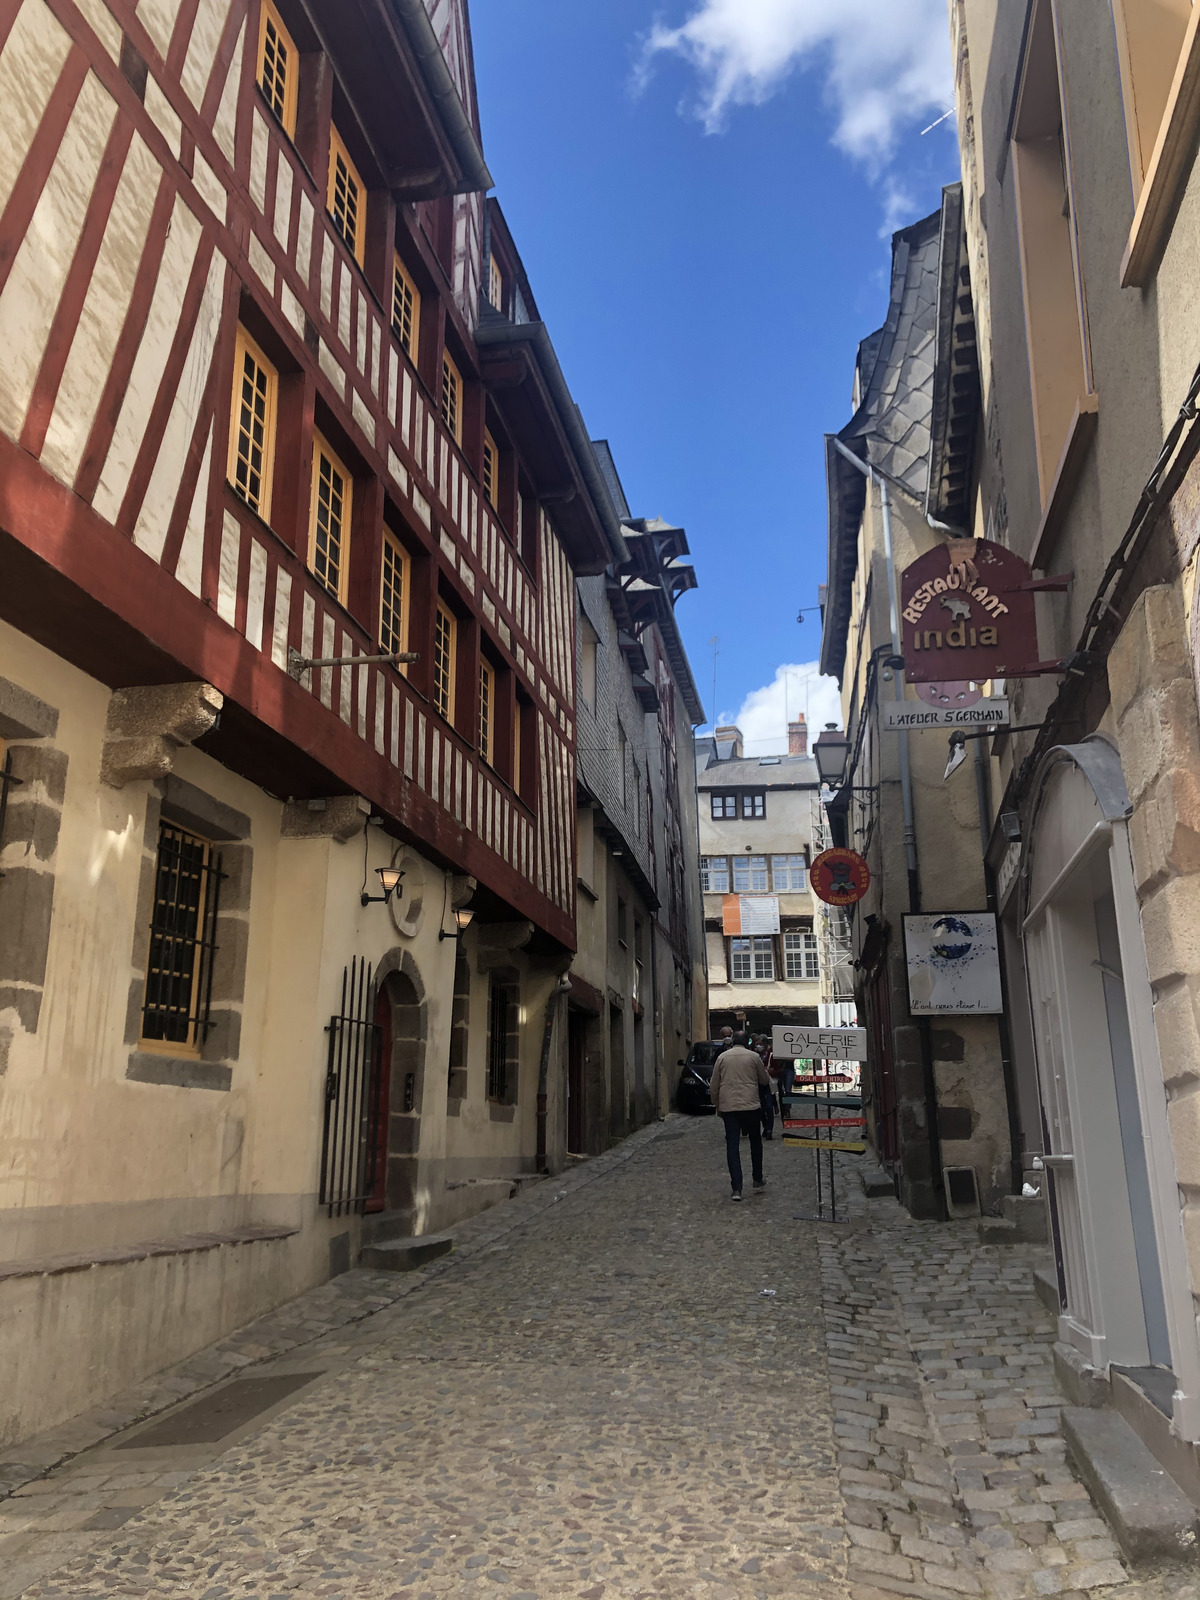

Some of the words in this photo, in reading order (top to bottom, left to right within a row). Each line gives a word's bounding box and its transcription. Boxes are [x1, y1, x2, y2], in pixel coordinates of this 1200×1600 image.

[914, 620, 998, 649] india
[889, 712, 939, 726] L'ATELIER
[911, 999, 932, 1010] L'art
[783, 1032, 857, 1047] GALERIE
[791, 1044, 852, 1058] D'ART
